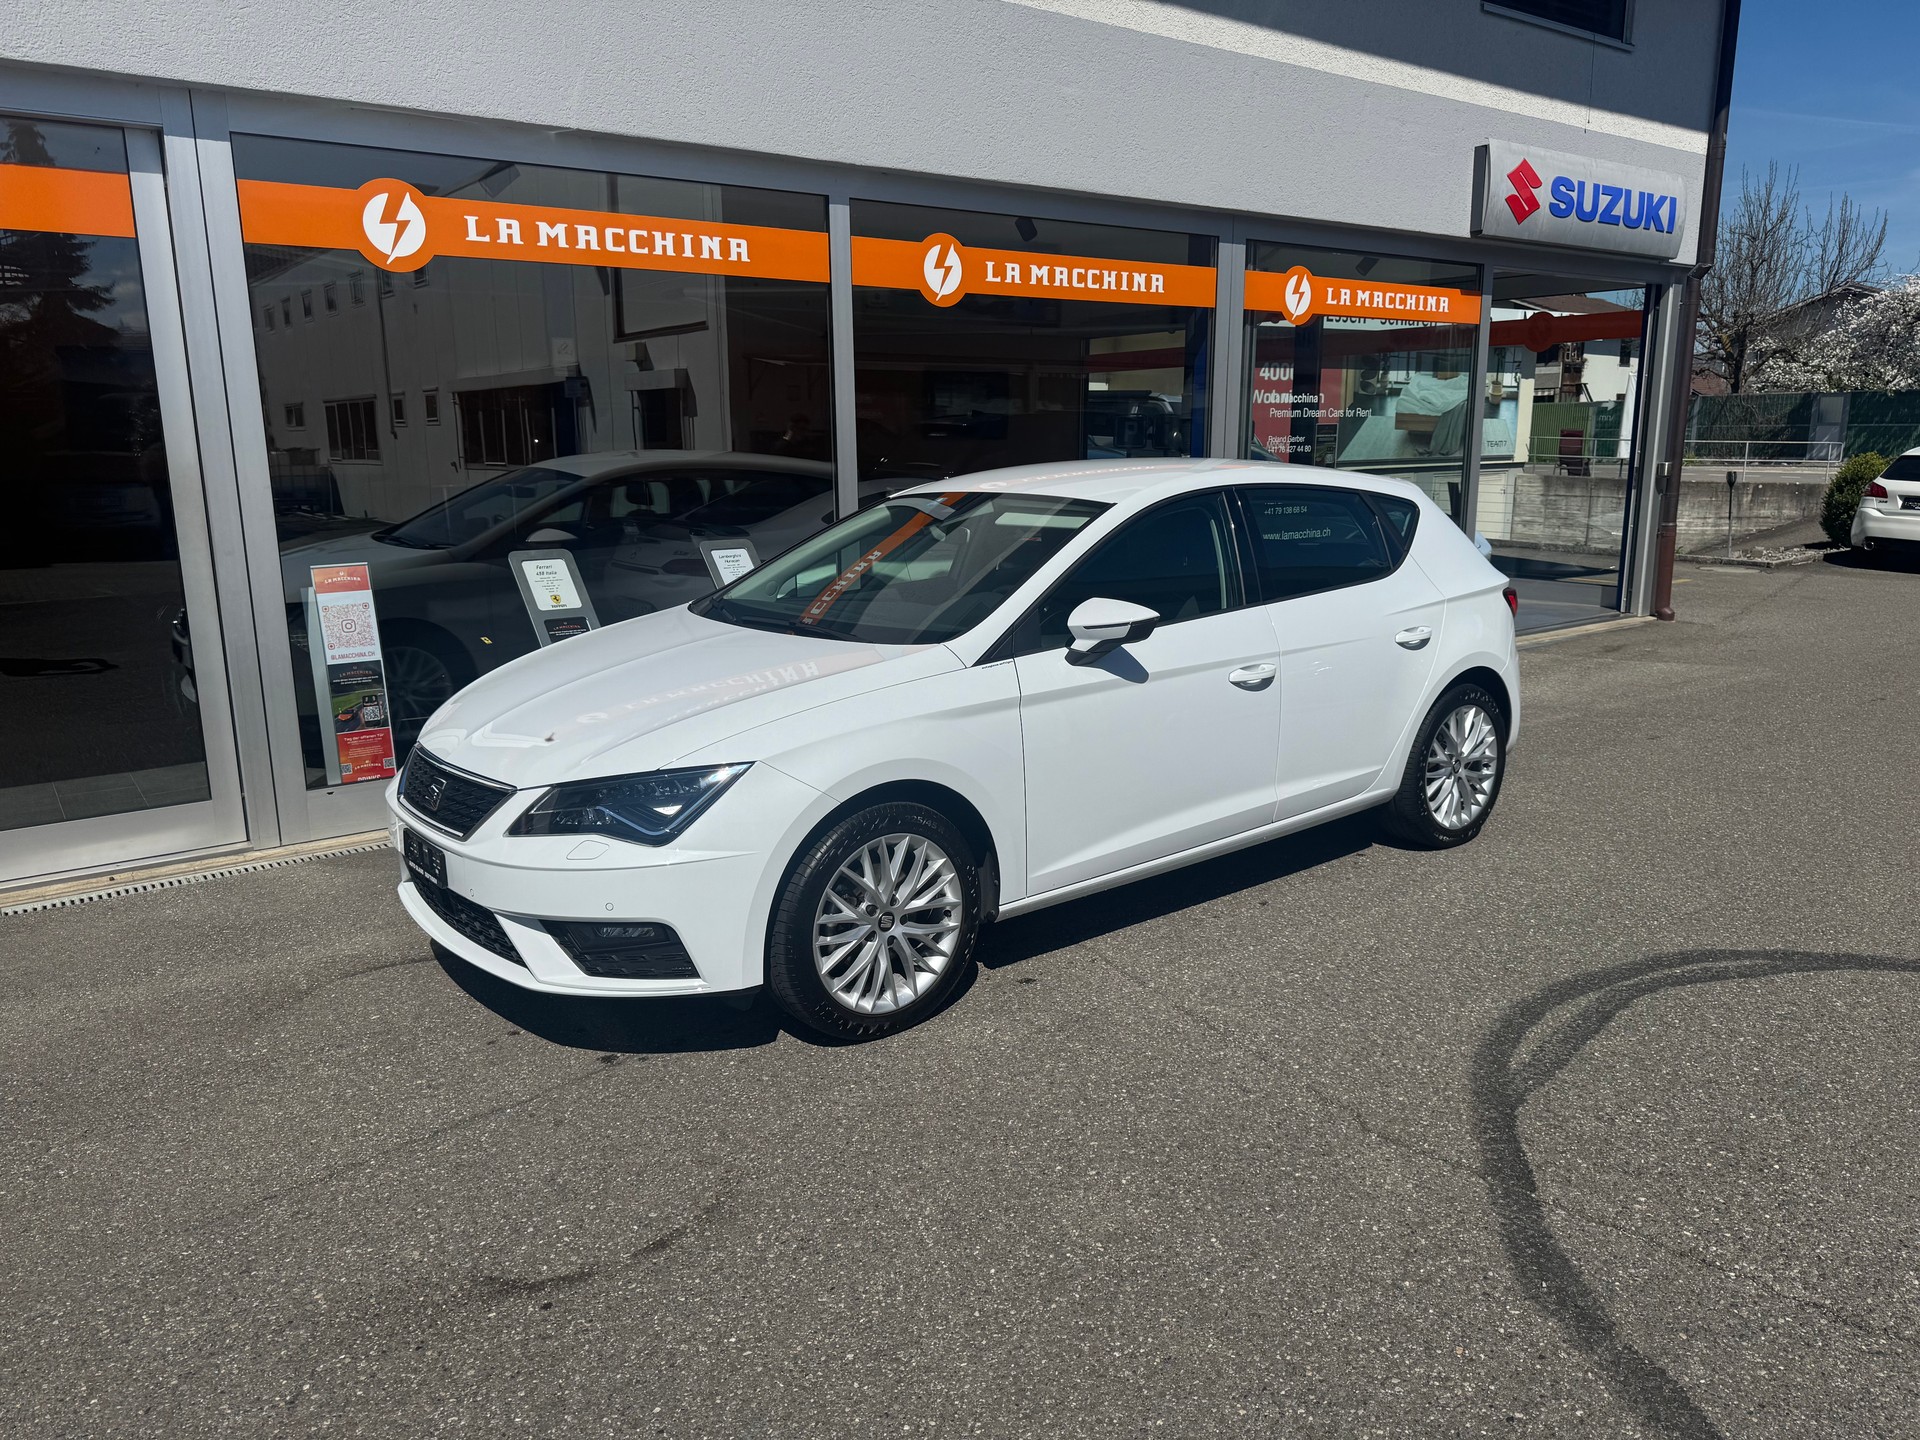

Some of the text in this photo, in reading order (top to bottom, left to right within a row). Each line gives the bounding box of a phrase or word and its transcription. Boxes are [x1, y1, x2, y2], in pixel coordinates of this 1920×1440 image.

[1549, 176, 1677, 234] SUZUKI
[464, 214, 751, 263] LA MACCHINA
[986, 261, 1165, 294] LA MACCHINA
[1326, 287, 1450, 313] LA MACCHINA
[1270, 407, 1372, 418] Premium Dream Cars for Rent
[1268, 435, 1305, 443] Roland Gerber
[1263, 527, 1331, 541] www.lamacchina.ch
